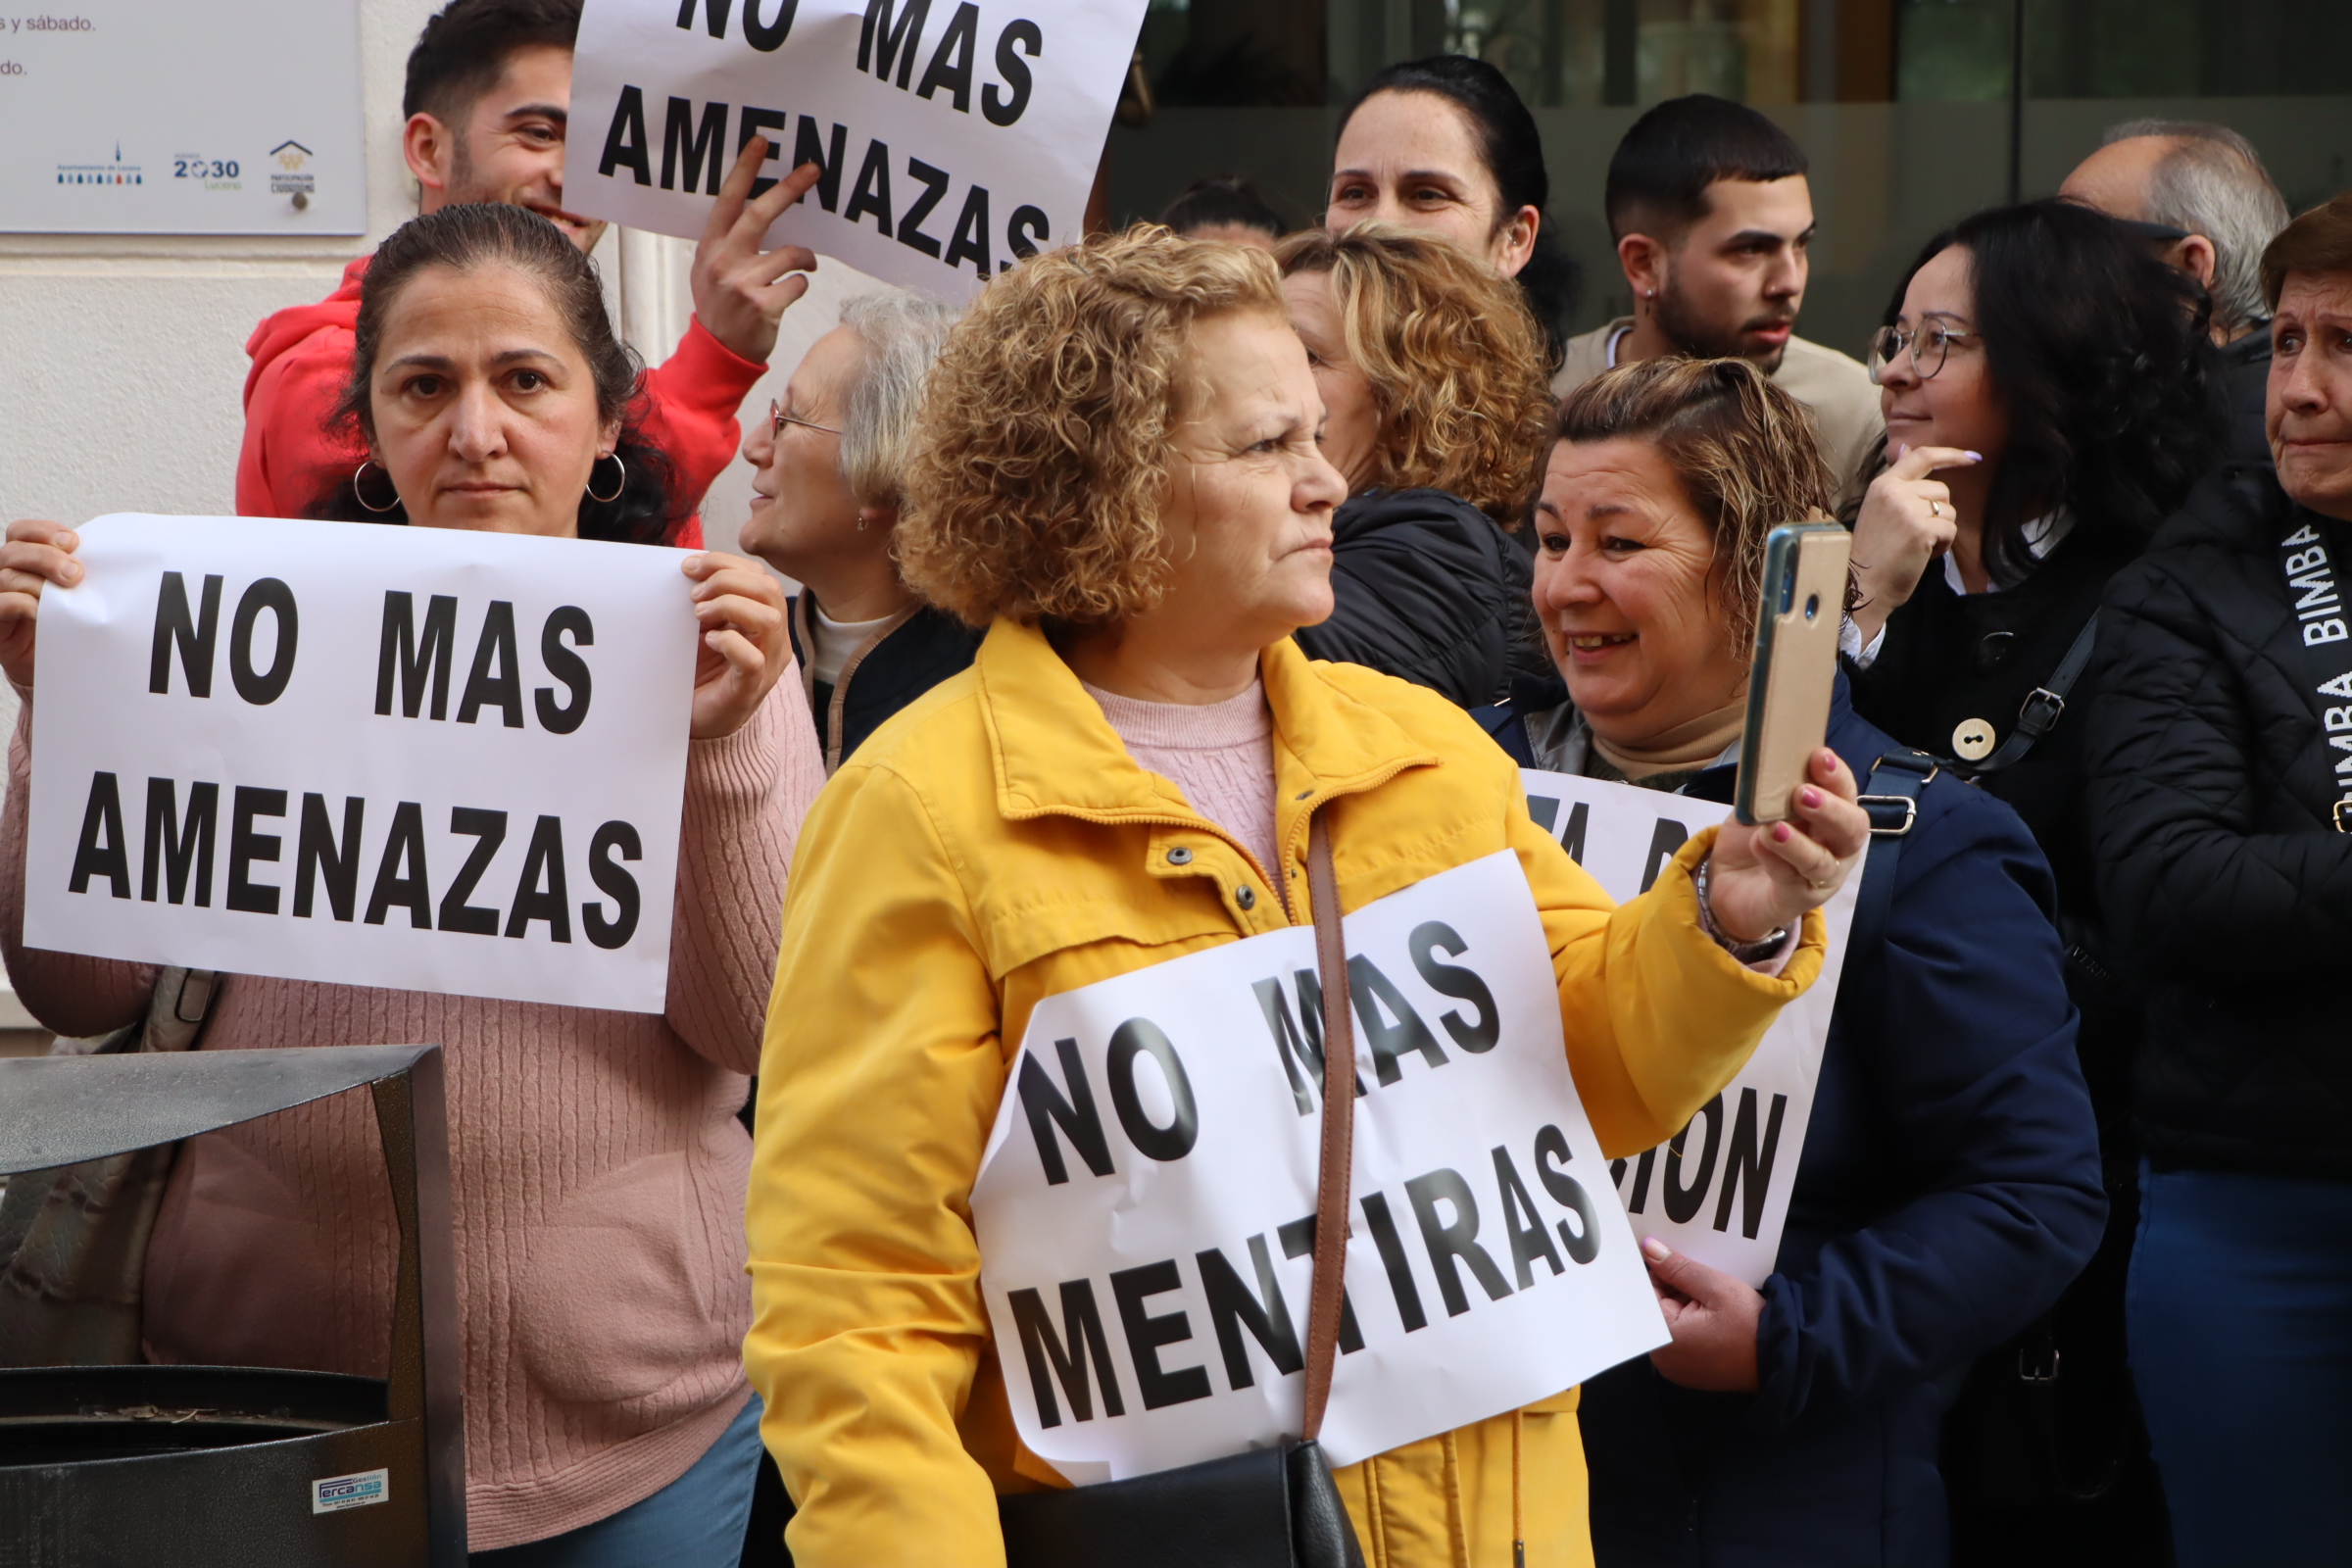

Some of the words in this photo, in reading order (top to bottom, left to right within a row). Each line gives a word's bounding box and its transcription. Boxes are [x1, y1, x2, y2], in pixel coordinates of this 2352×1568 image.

[12, 18, 21, 33] y
[26, 14, 96, 31] sábado.
[857, 0, 1042, 126] MAS
[598, 84, 1050, 281] AMENAZAS
[149, 570, 299, 706] NO
[374, 590, 595, 734] MAS
[2281, 524, 2349, 647] BIMBA
[2317, 670, 2352, 813] MBA
[69, 771, 643, 950] AMENAZAS
[1017, 1016, 1199, 1186] NO
[1250, 920, 1500, 1117] MAS
[319, 1478, 381, 1497] Fercansa
[353, 1473, 382, 1484] Gestión
